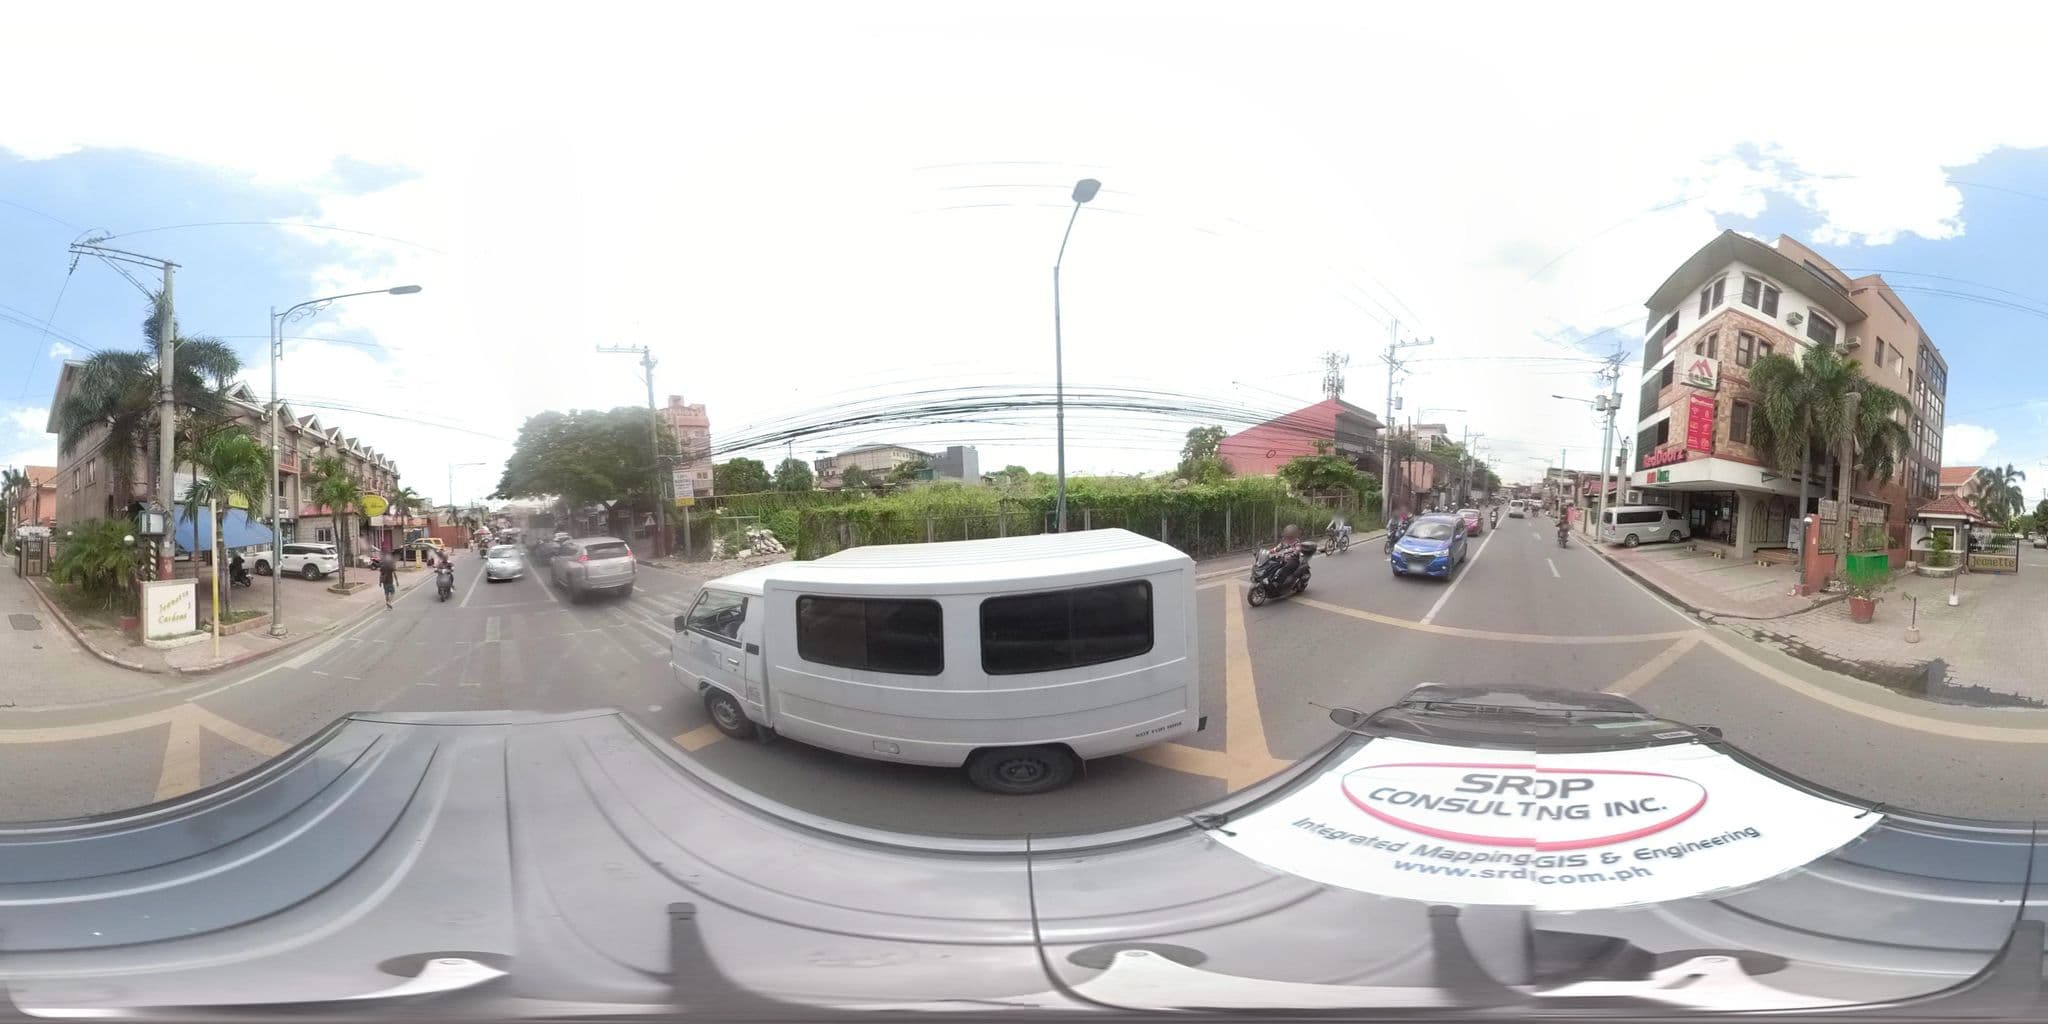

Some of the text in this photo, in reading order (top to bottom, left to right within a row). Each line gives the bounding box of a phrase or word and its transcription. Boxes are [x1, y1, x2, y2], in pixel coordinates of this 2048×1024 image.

[1604, 797, 1668, 817] INC.
[1291, 817, 1407, 853] Integrated
[1535, 854, 1588, 869] GIS
[1601, 852, 1622, 865] &
[1633, 826, 1761, 861] Engineering
